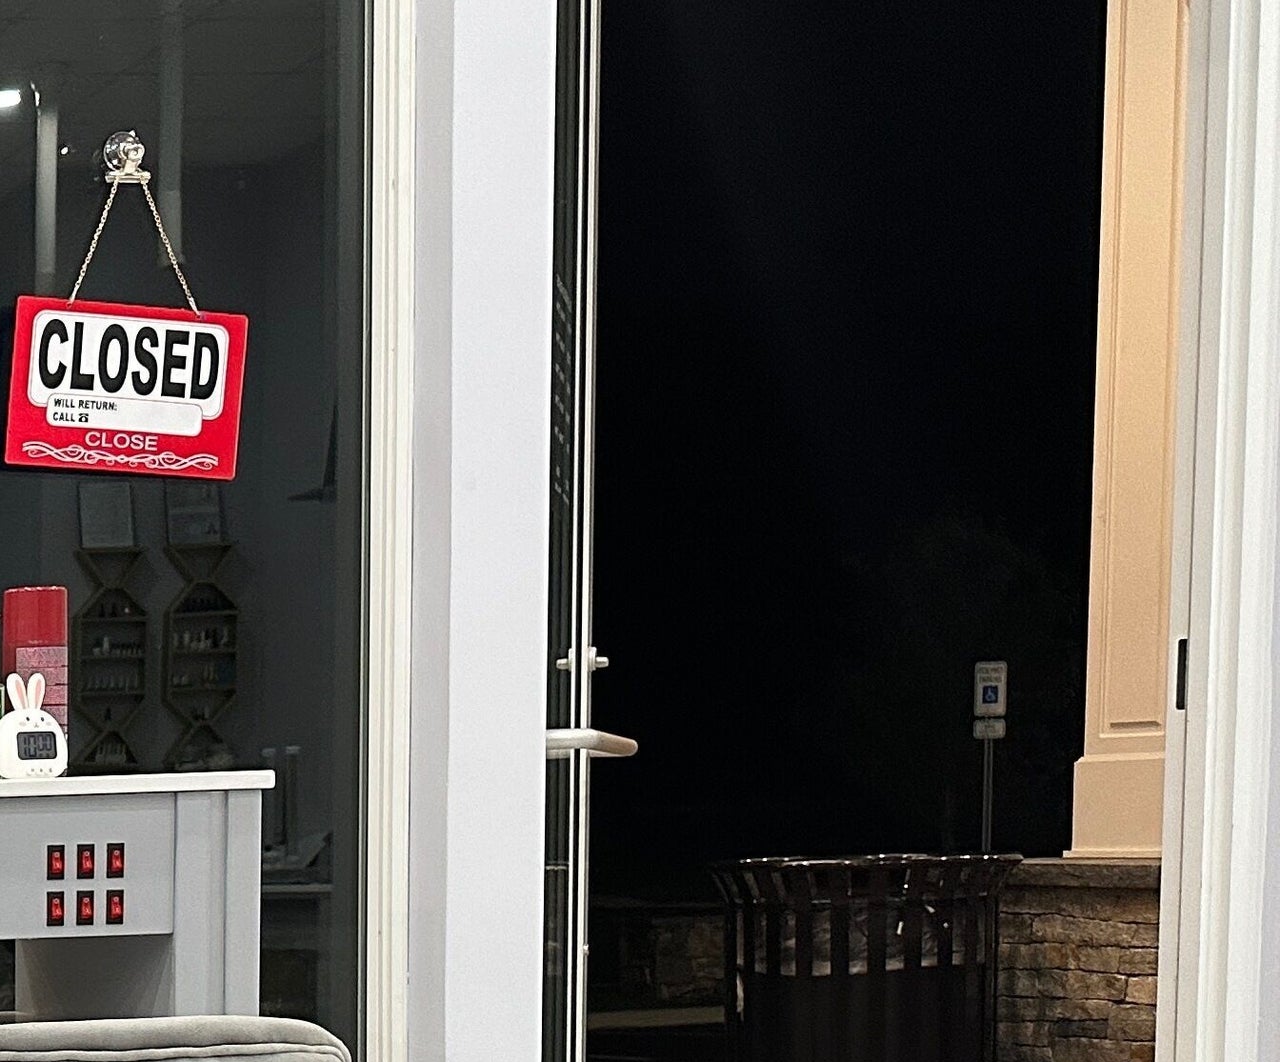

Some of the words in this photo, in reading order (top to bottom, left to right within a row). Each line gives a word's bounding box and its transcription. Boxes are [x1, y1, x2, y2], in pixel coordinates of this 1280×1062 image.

[38, 319, 220, 400] CLOSED
[53, 398, 75, 410] WILL
[78, 399, 118, 411] RETURN:
[53, 411, 76, 423] CALL
[84, 430, 159, 452] CLOSE
